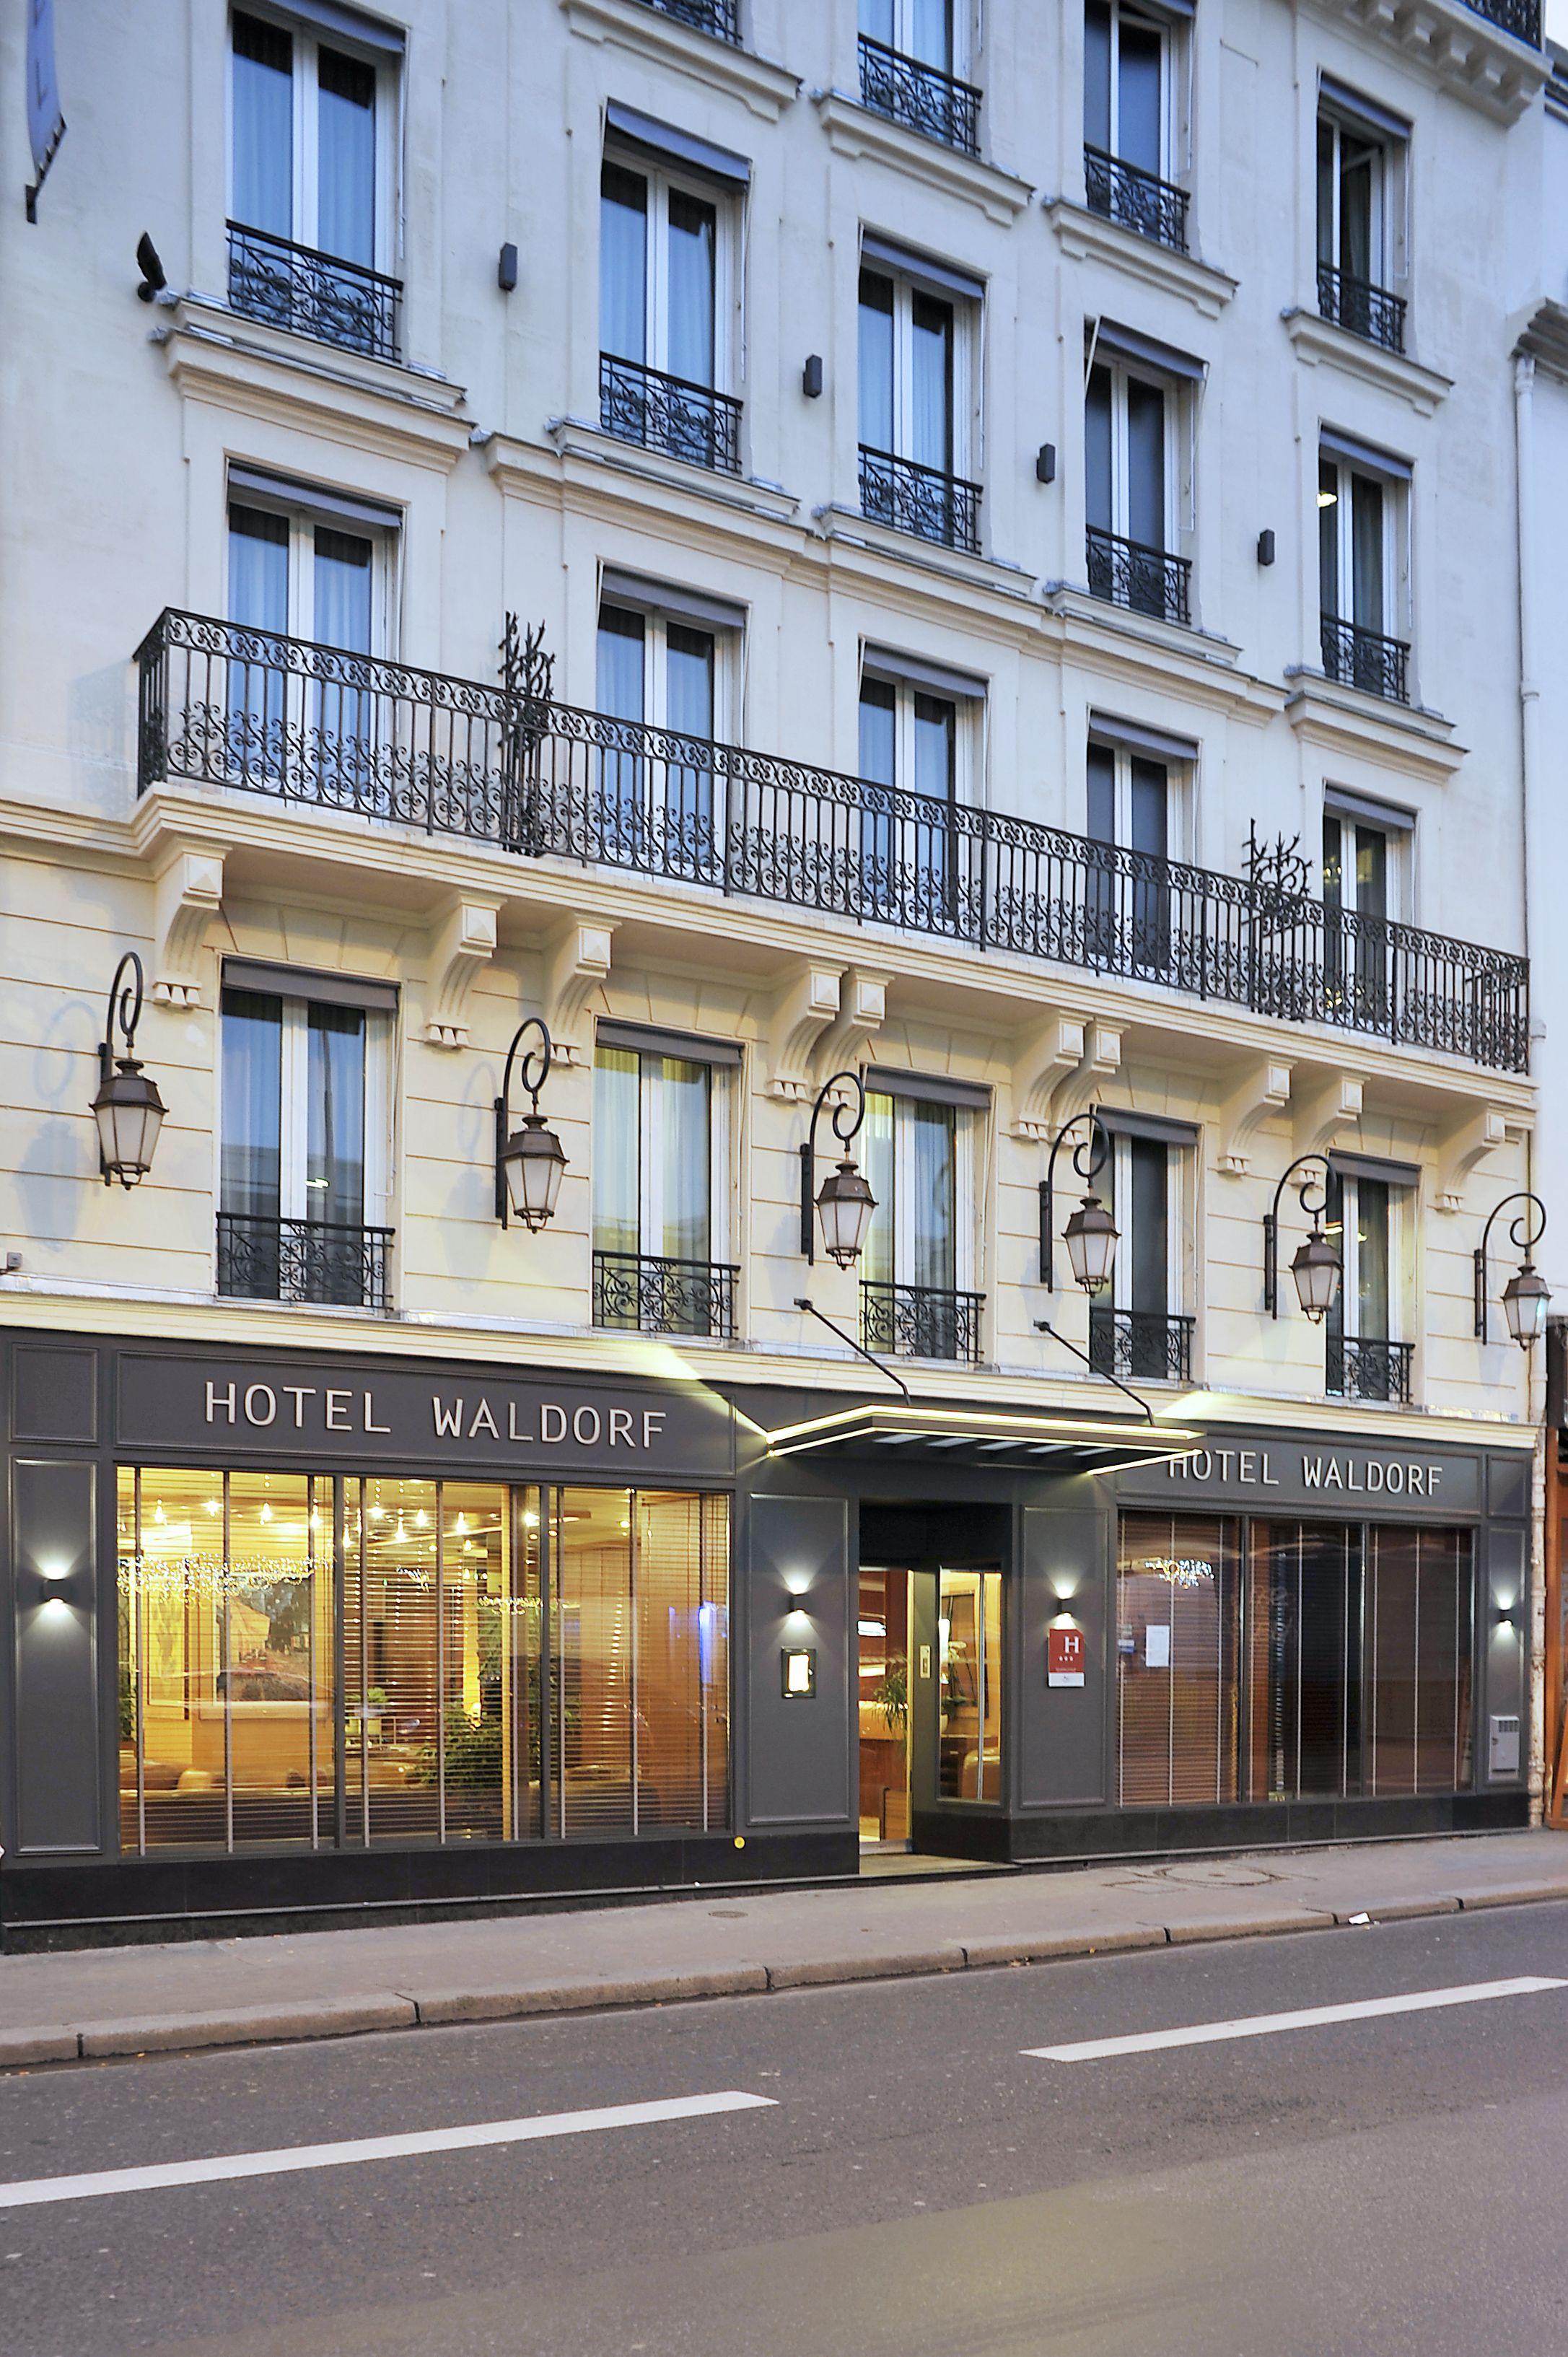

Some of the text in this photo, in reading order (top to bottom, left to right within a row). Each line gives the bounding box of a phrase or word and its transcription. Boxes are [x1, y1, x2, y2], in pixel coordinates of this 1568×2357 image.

[206, 1381, 667, 1448] HOTEL WALDORF
[1169, 1449, 1442, 1496] HOTEL WALDORF
[1064, 1635, 1079, 1653] H
